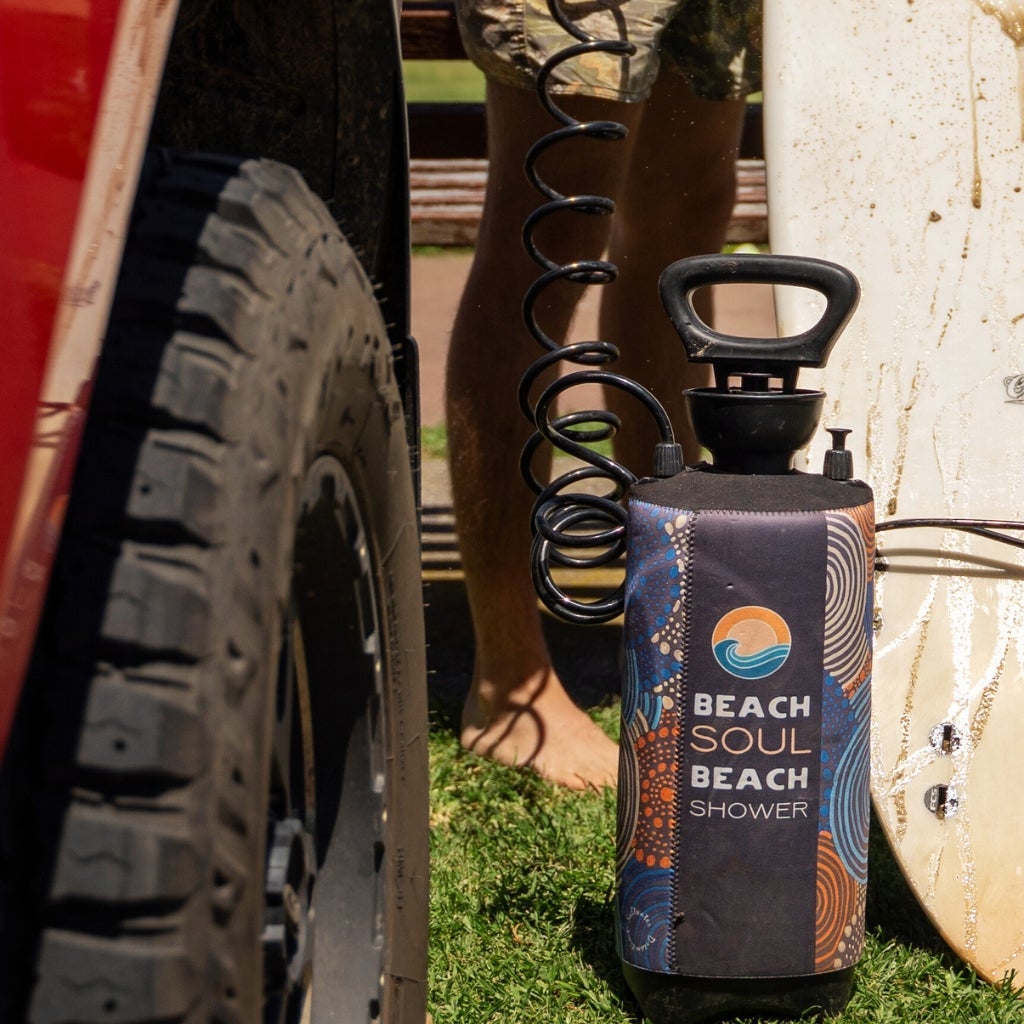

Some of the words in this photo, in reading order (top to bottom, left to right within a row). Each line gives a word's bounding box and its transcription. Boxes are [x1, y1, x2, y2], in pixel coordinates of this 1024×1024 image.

[694, 693, 810, 718] BEACH
[690, 725, 811, 754] SOUL
[691, 765, 808, 790] BEACH
[690, 800, 808, 819] SHOWER
